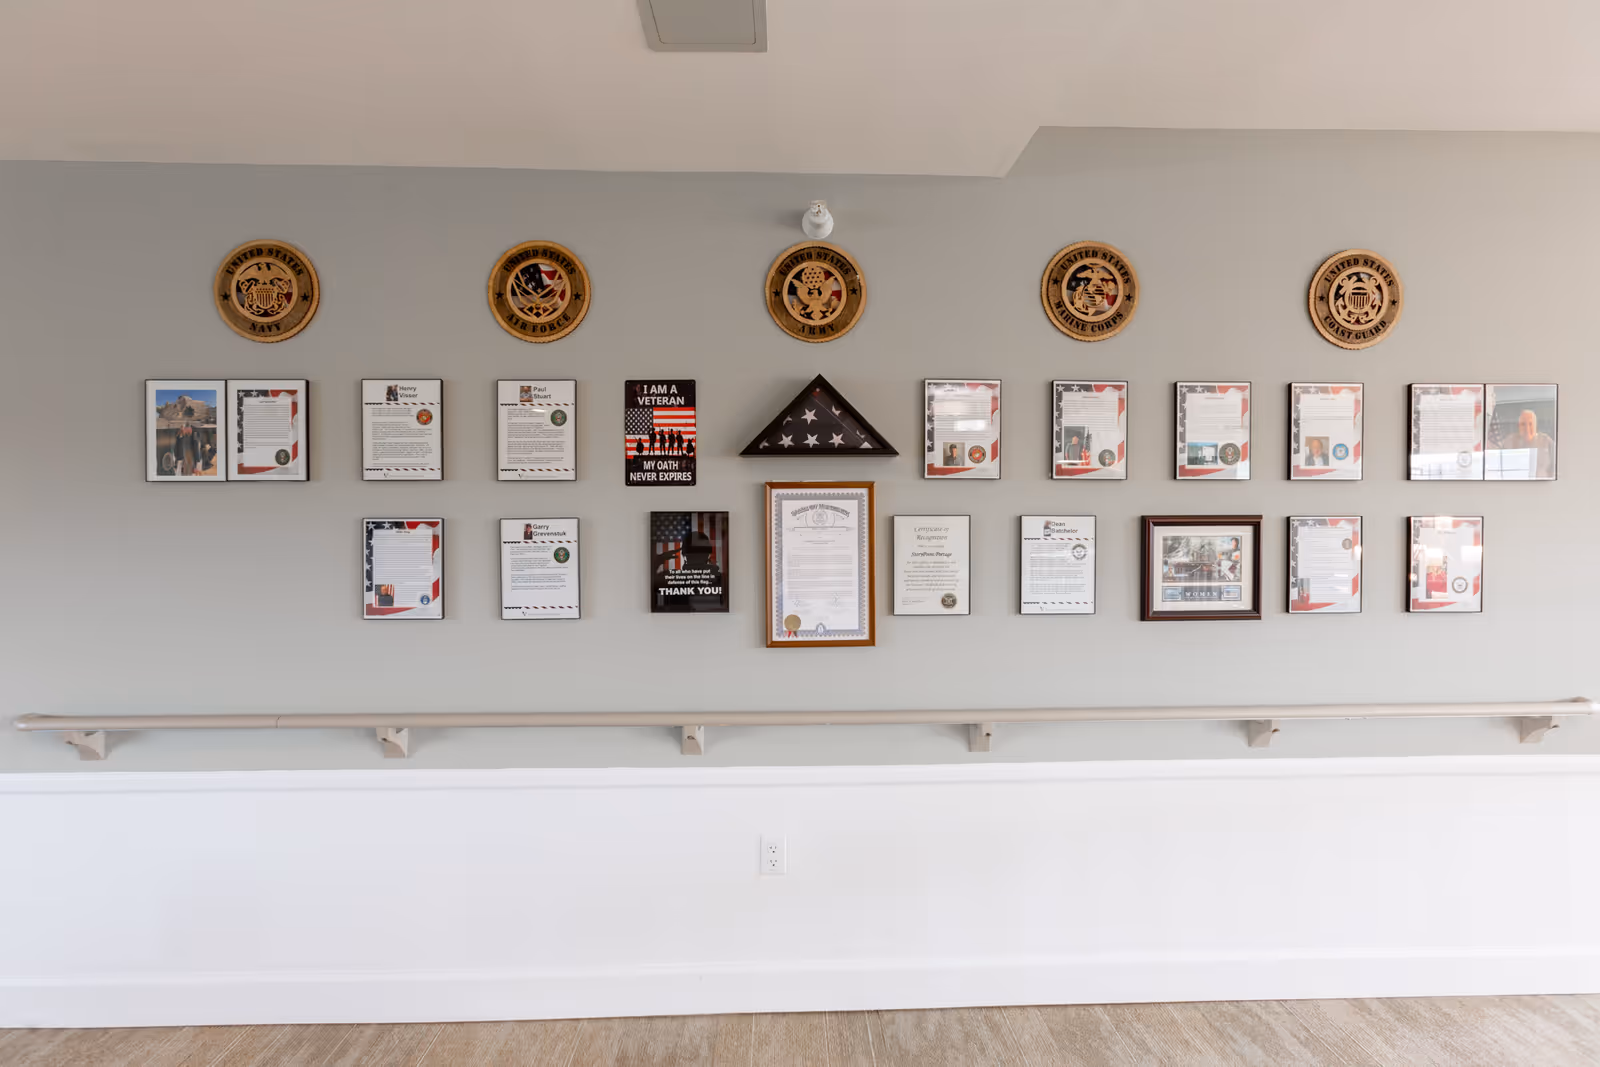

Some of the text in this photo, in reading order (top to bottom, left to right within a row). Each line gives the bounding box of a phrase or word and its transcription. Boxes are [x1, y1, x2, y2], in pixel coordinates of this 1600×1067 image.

[226, 248, 304, 276] UNITED STATES
[503, 249, 576, 275] UNITED STATES
[779, 251, 852, 275] UNITED STATES
[1060, 250, 1131, 284] UNITED STATES
[1324, 258, 1394, 287] UNITED STATES
[507, 313, 571, 333] AIR FORCE
[1054, 300, 1124, 333] MARINE CORPS
[249, 323, 281, 333] NAVY
[799, 323, 835, 335] ARMY
[1324, 316, 1387, 340] COAST GUARD
[643, 385, 678, 394] I AM A
[637, 396, 685, 405] VETERAN
[643, 461, 679, 470] MY OATH
[630, 472, 692, 481] NEVER EXPIRES
[658, 587, 722, 595] THANK YOU!
